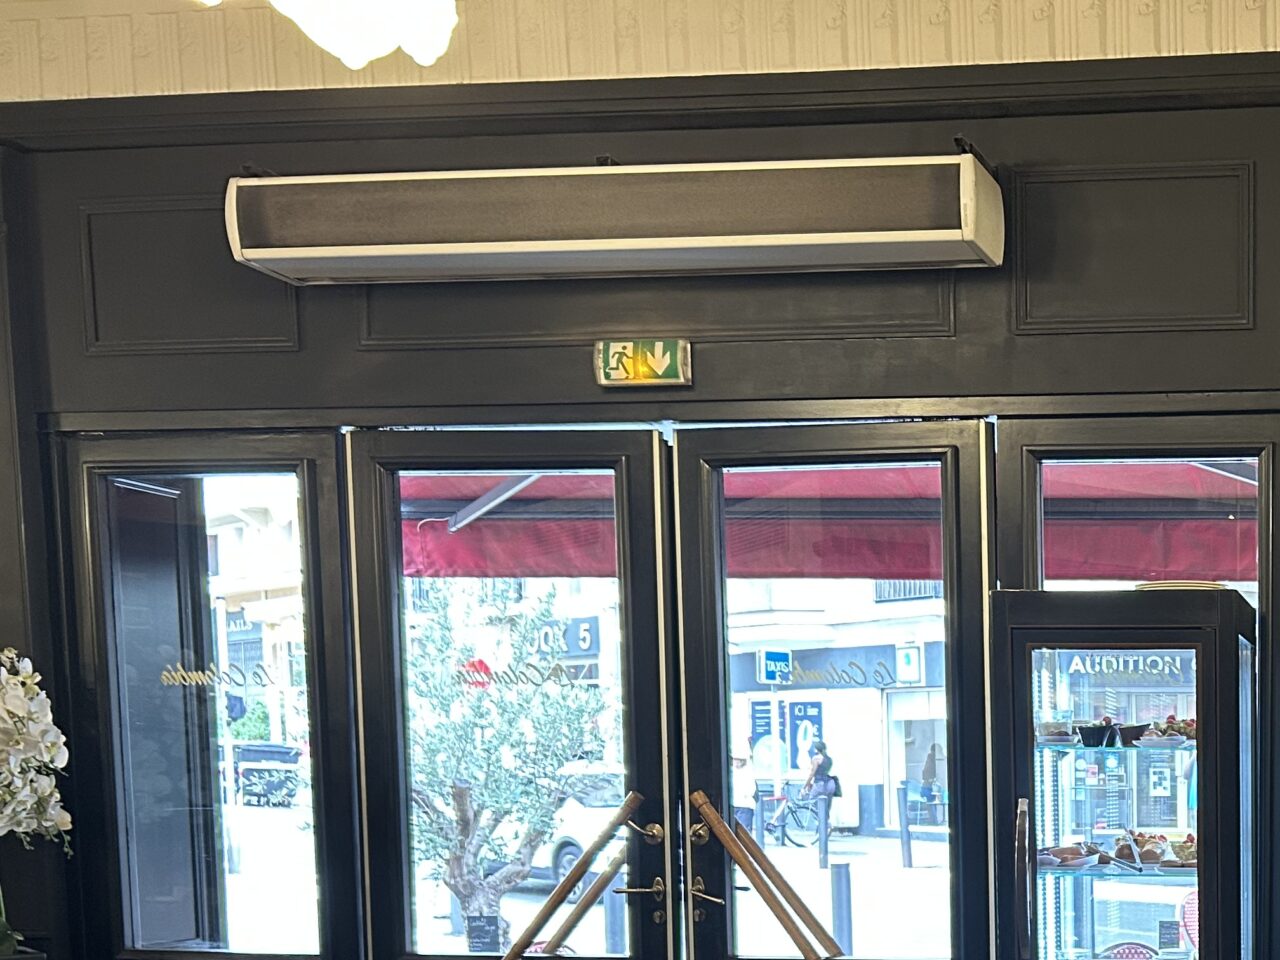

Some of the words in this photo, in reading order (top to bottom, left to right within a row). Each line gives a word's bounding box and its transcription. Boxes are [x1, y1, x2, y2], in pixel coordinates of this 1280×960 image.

[579, 623, 591, 649] 5
[766, 659, 789, 673] TAXIS
[1068, 655, 1182, 674] AUDITION
